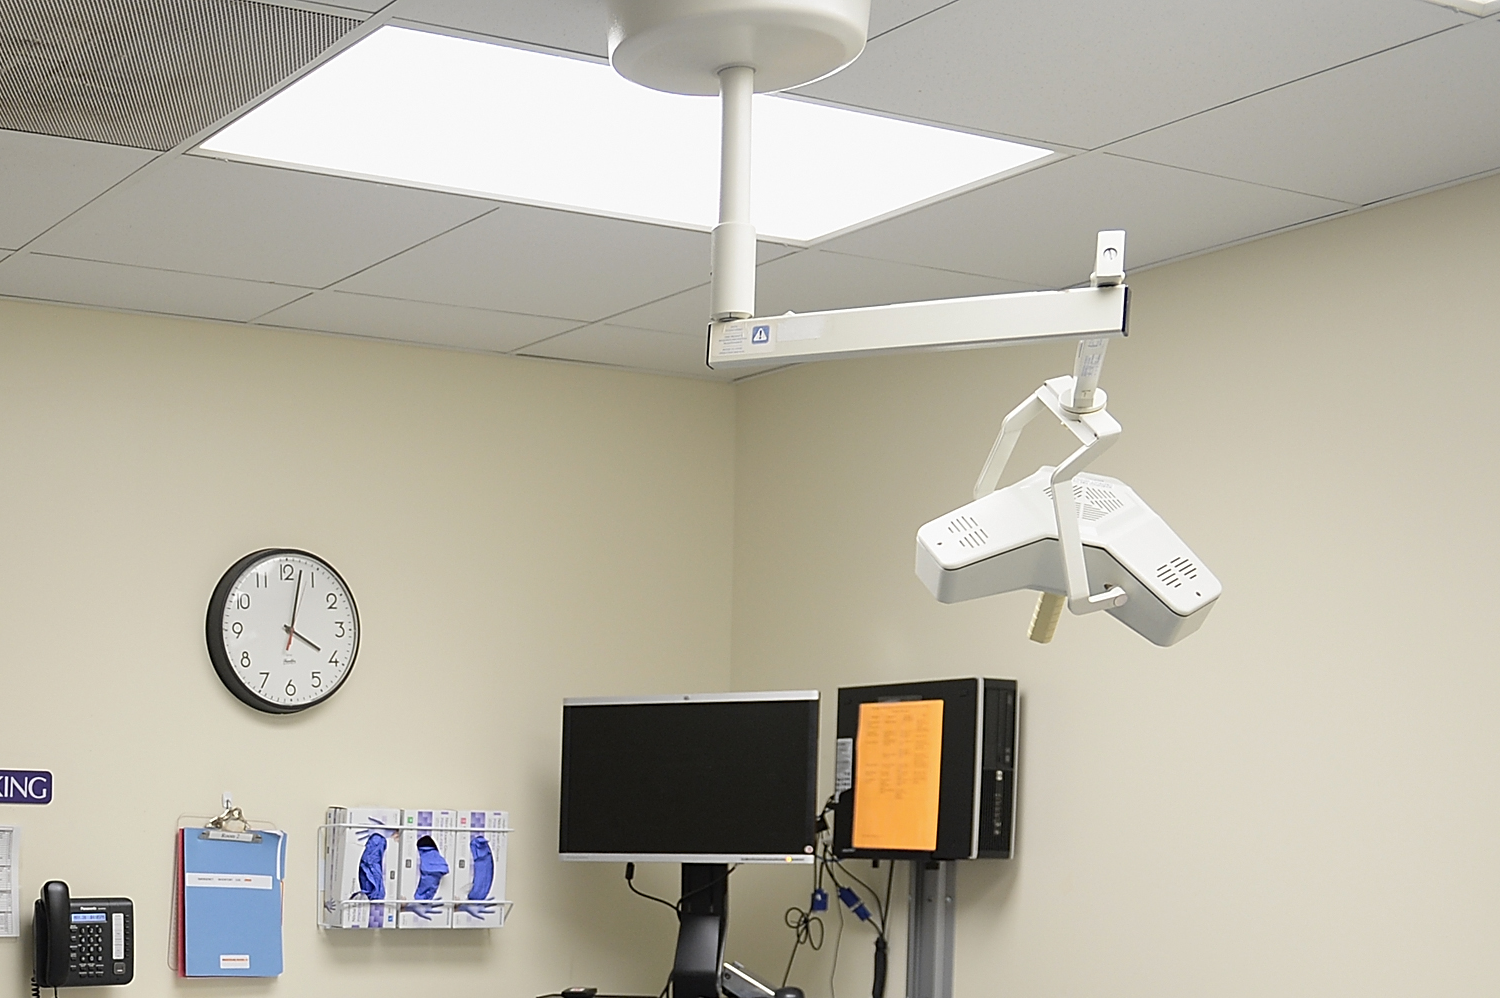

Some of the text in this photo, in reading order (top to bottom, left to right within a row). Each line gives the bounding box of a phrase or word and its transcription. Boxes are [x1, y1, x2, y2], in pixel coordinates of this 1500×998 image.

[256, 571, 268, 588] 11
[279, 563, 295, 581] 12
[311, 571, 315, 588] 1
[236, 592, 251, 610] 10
[326, 592, 338, 610] 2
[231, 621, 244, 639] 9
[334, 621, 346, 638] 3
[240, 650, 251, 668] 8
[328, 649, 340, 667] 4
[259, 671, 270, 689] 7
[285, 679, 297, 697] 6
[311, 671, 322, 688] 5
